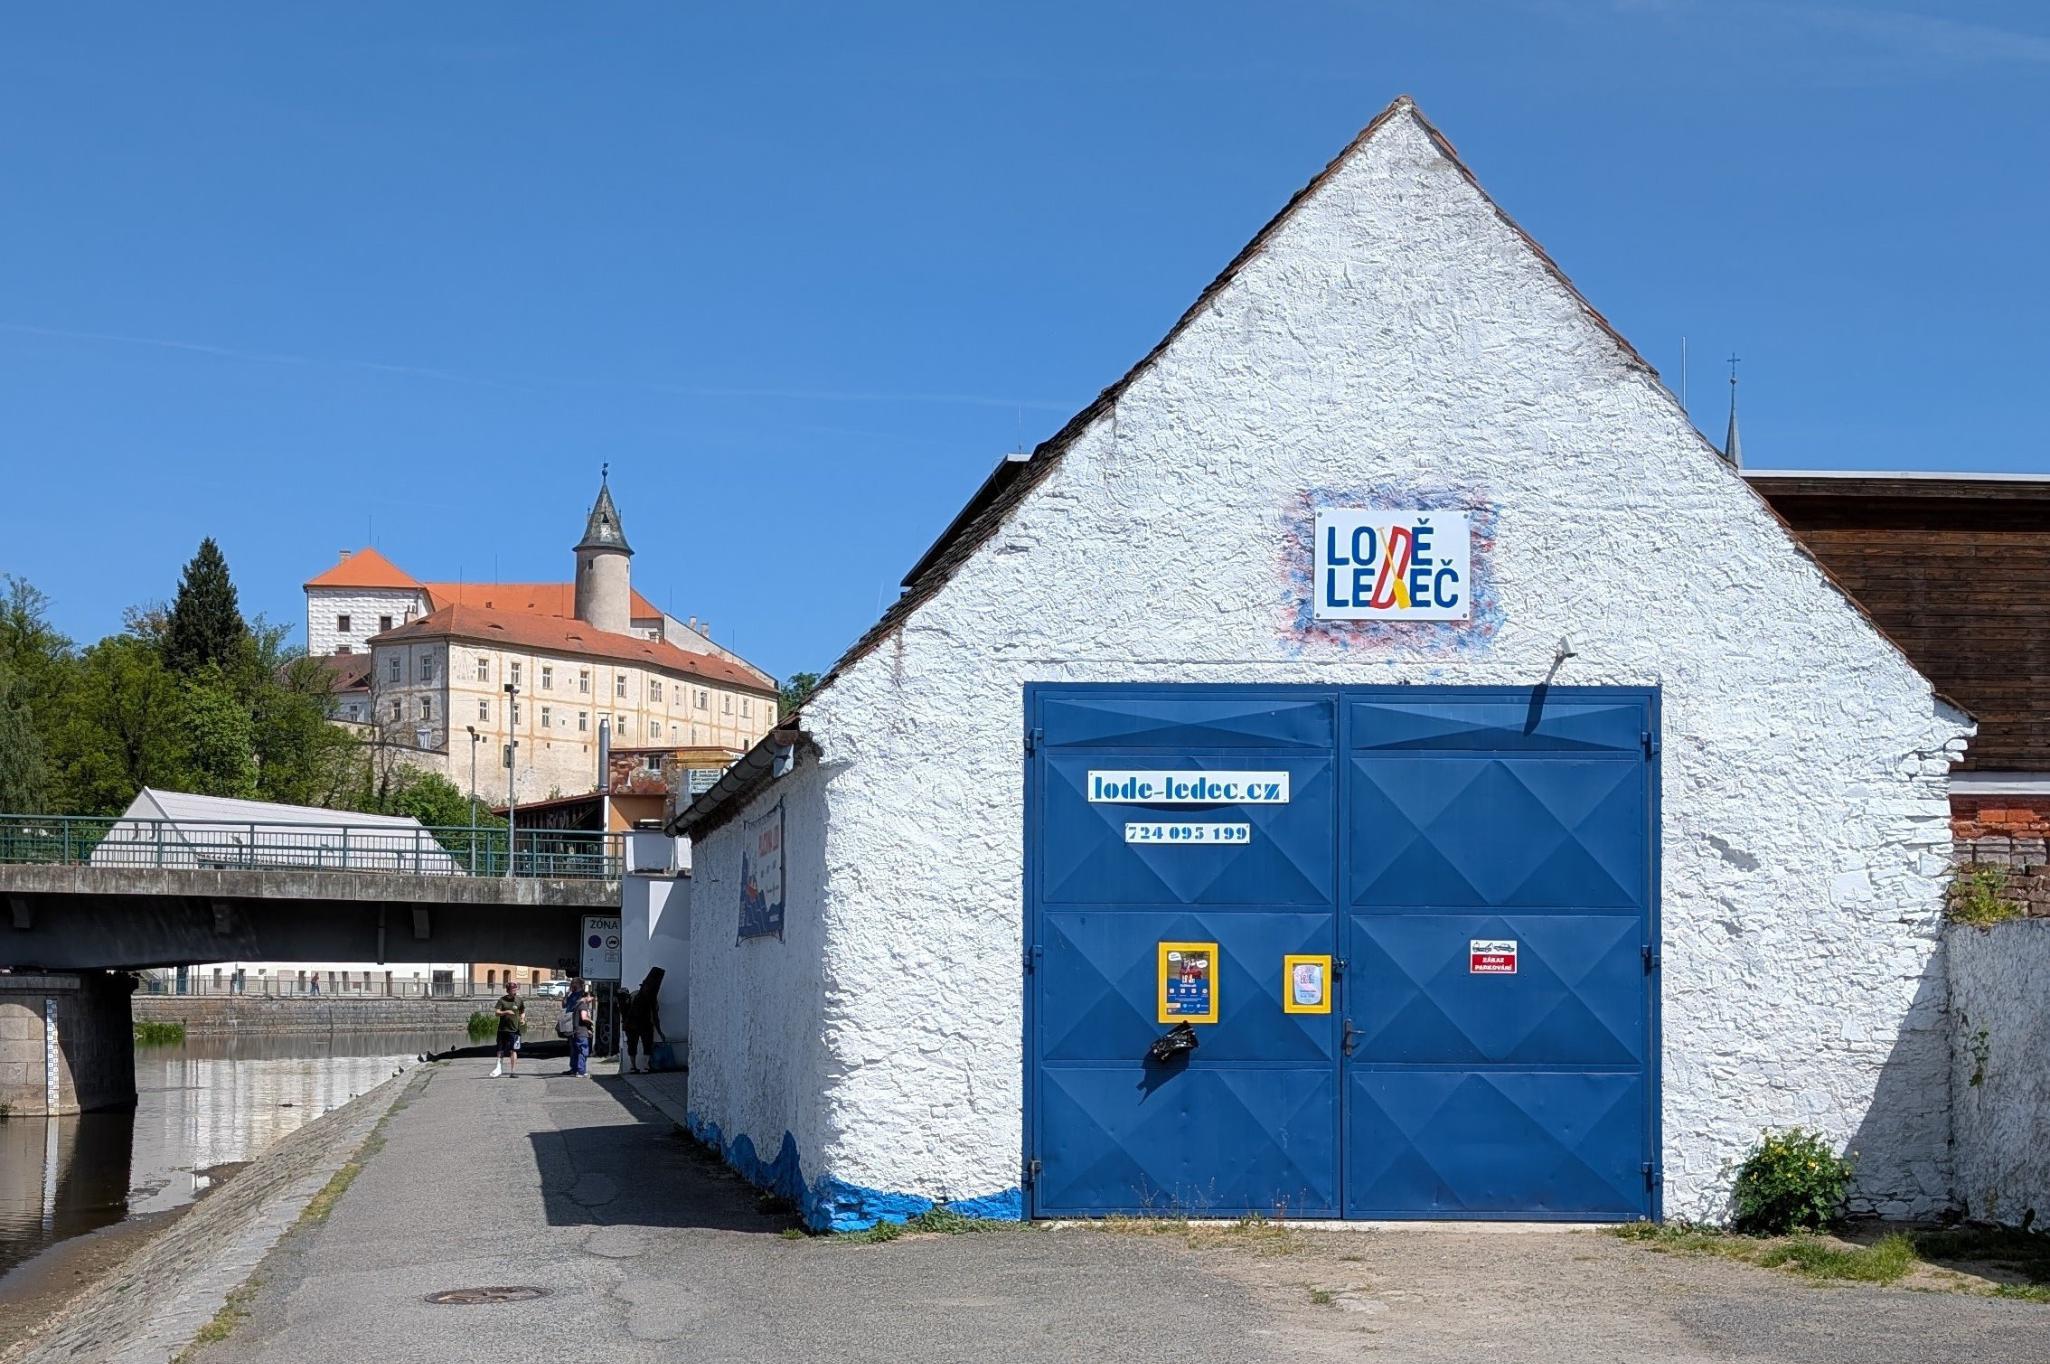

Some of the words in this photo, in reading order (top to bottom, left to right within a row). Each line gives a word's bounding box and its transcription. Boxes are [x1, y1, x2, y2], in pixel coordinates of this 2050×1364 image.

[1327, 517, 1435, 566] LODĚ
[1326, 558, 1460, 610] LEDEČ
[1094, 776, 1281, 801] lode-ledec.cz
[1127, 826, 1164, 840] 724
[1169, 826, 1205, 840] 095
[1213, 826, 1248, 840] 199
[589, 918, 619, 930] ZÓNA
